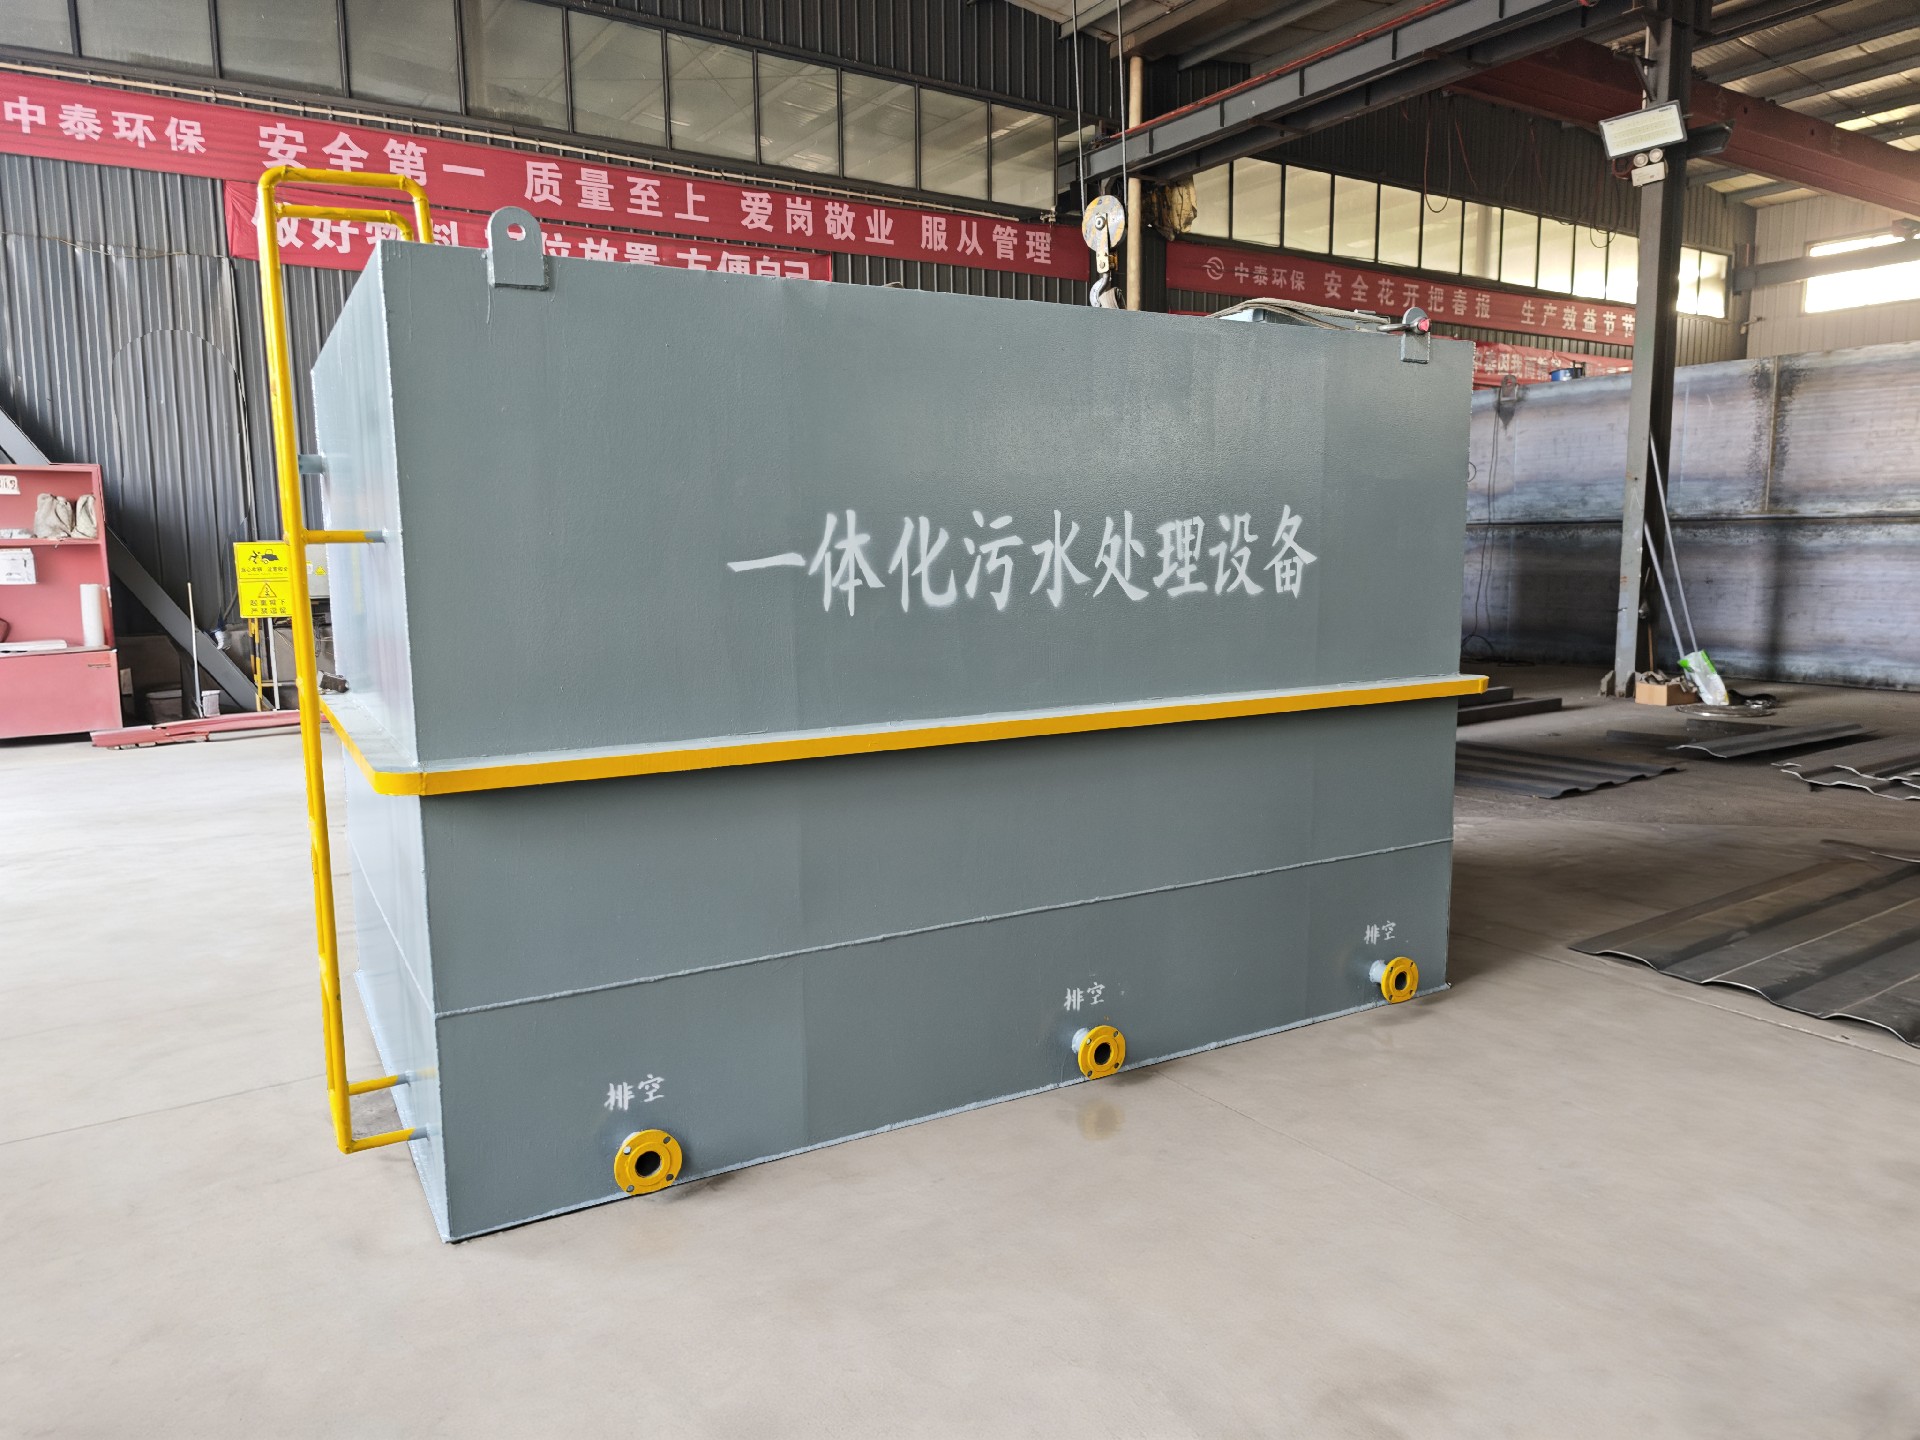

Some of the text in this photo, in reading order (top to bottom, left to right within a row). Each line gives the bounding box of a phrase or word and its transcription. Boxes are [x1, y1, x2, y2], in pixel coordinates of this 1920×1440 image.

[4, 96, 1052, 265] 中泰环保 安全第一 质量至上 爱岗敬业 服从管理
[1234, 262, 1305, 292] 中泰环保
[1323, 270, 1491, 319] 安全花开把春报
[727, 504, 1318, 617] 一体化污水处理设备
[1363, 920, 1397, 945] 排空
[1063, 981, 1106, 1012] 排空
[603, 1073, 665, 1112] 排空
